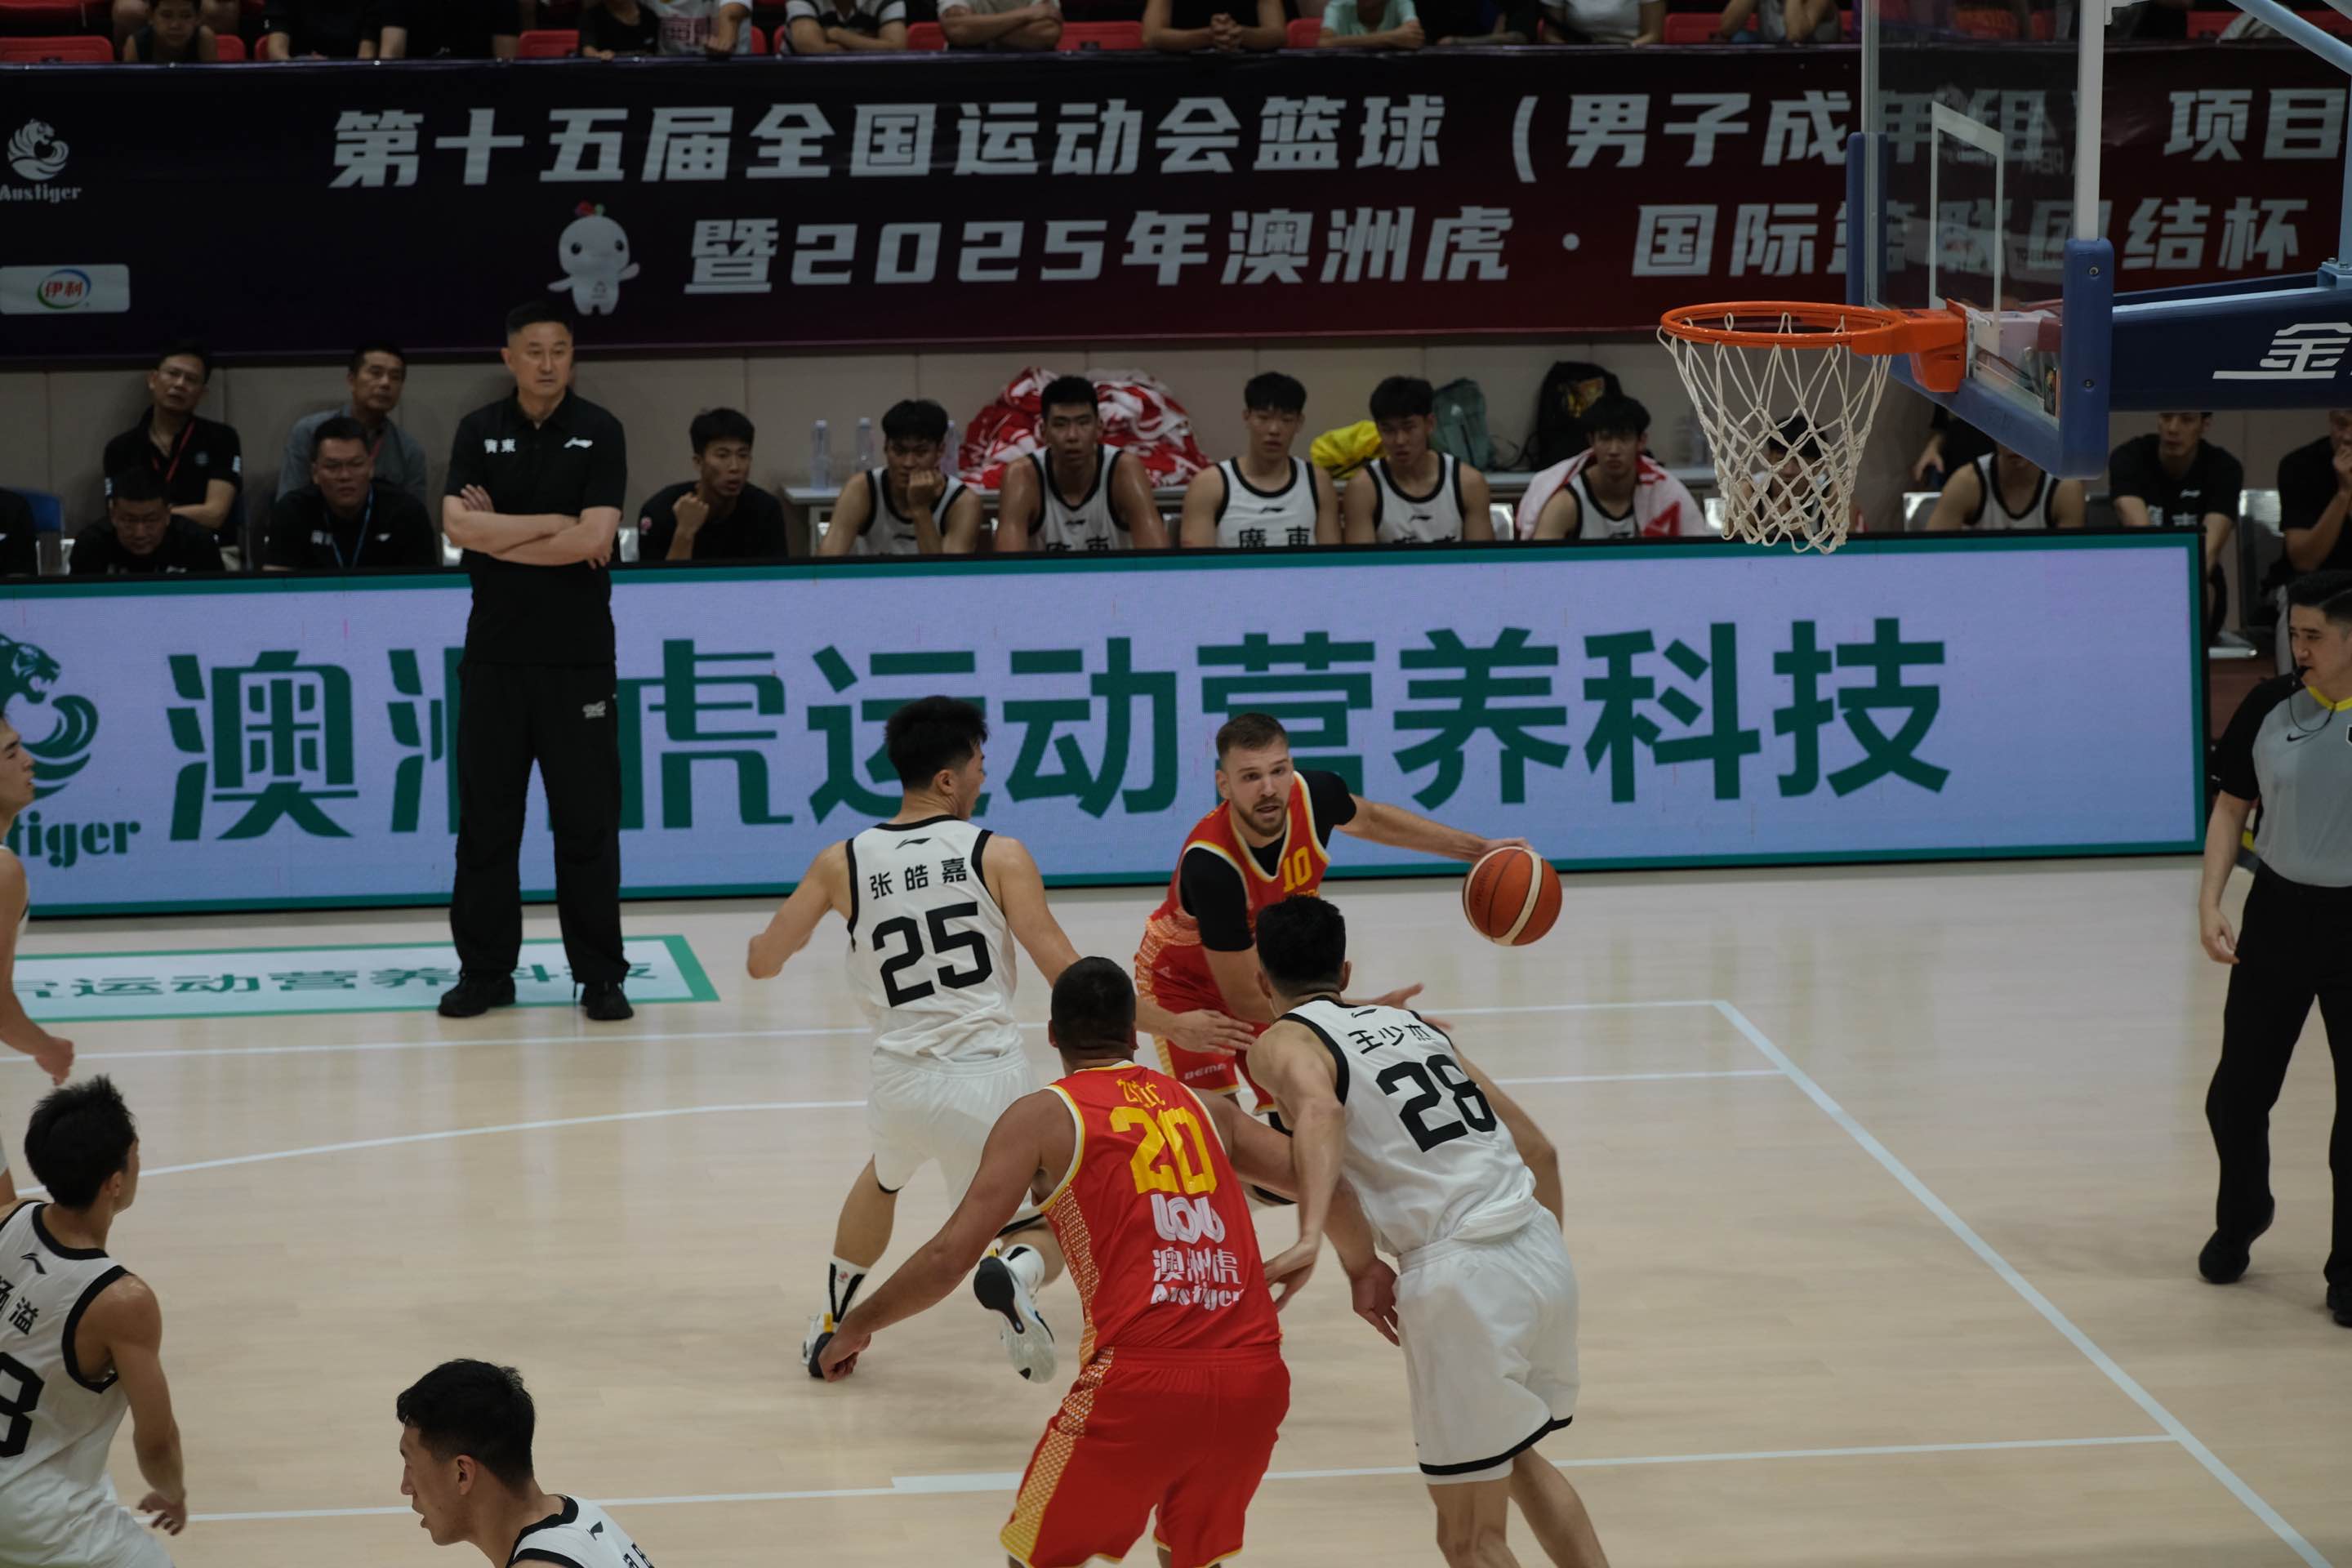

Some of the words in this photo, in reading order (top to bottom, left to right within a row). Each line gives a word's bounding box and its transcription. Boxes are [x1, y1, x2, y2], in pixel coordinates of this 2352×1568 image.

[44, 281, 83, 296] 伊利
[869, 858, 967, 900] 张皓嘉
[1282, 845, 1312, 893] 10
[872, 902, 992, 1008] 25
[1375, 1054, 1497, 1153] 28
[1109, 1106, 1218, 1195] 20
[1152, 1246, 1242, 1285] 澳洲虎
